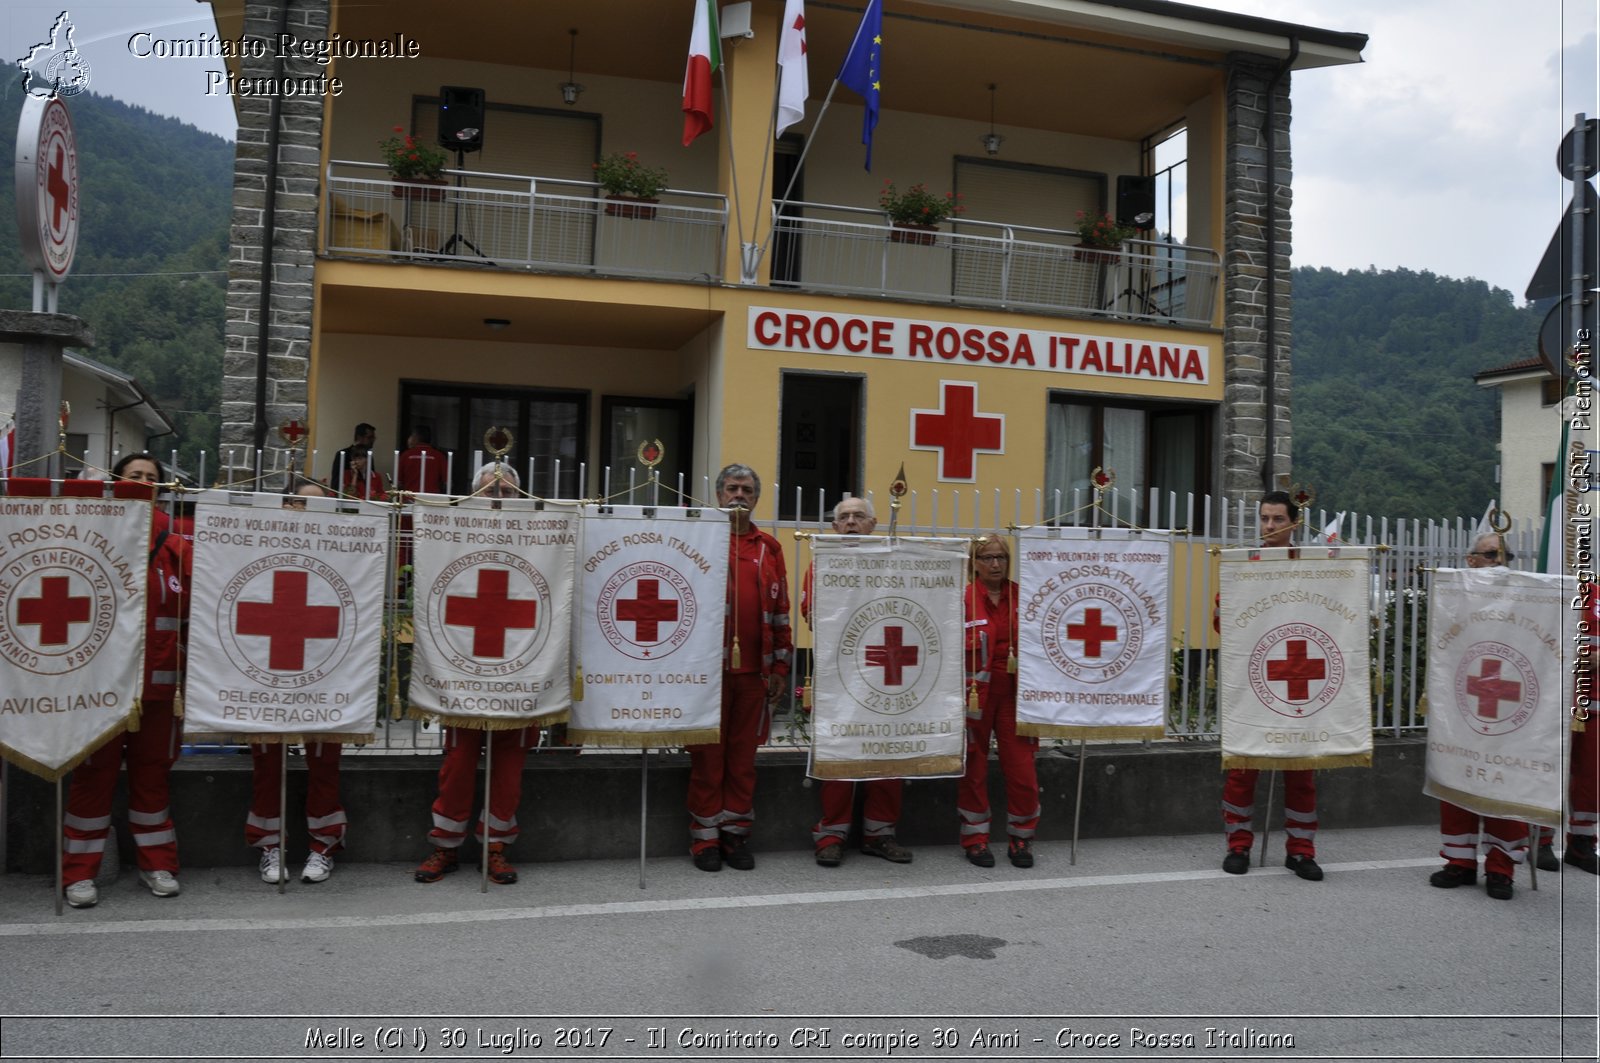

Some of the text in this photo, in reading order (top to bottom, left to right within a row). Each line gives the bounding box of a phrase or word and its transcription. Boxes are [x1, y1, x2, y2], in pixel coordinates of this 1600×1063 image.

[754, 311, 1205, 381] CROCE ROSSA ITALIANA
[50, 504, 70, 516] DEL
[75, 504, 126, 517] SOCCORSO
[207, 515, 377, 539] CORPO VOLONTARI DEL SOCCORSO
[422, 513, 569, 531] CORPO VOLONTARI DEL SOCCORSO
[197, 530, 385, 555] CROCE ROSSA ITALIANA
[415, 528, 576, 546] CROCE ROSSA ITALIANA
[8, 523, 140, 600] ROSSA ITALIANA
[584, 532, 712, 575] CROCE ROSSA ITALIANA
[1026, 551, 1053, 562] CORPO
[1056, 551, 1100, 563] VOLONTARI
[1104, 552, 1119, 563] DEL
[10, 561, 26, 577] DI
[31, 551, 95, 575] GINEVRA
[94, 575, 108, 592] 22
[223, 555, 353, 608] CONVENZIONE DI GINEVRA
[432, 552, 549, 600] CONVENZIONE DI GINEVRA
[822, 574, 956, 588] CROCE ROSSA ITALIANA
[1024, 564, 1162, 626] CROCE ROSSA ITALIANA
[600, 580, 622, 646] CONVENZIONE
[617, 571, 628, 582] DI
[628, 564, 671, 579] GINEVRA
[670, 574, 684, 588] 22
[679, 586, 695, 627] AGOSTO
[1060, 594, 1073, 606] DI
[1123, 606, 1137, 620] 22
[1234, 590, 1358, 629] CROCE ROSSA ITALIANA
[93, 595, 113, 642] AGOSTO
[1470, 609, 1516, 624] ROSSA
[841, 600, 939, 656] CONVENZIONE DI GINEVRA
[66, 643, 97, 667] 1864
[1251, 640, 1275, 705] CONVENZIONE
[1266, 633, 1278, 644] DI
[1278, 625, 1317, 639] GINEVRA
[1317, 634, 1330, 647] 22
[423, 674, 482, 692] COMITATO
[487, 681, 541, 693] LOCALE
[585, 673, 708, 685] COMITATO LOCALE
[218, 689, 351, 705] DELEGAZIONE DI
[439, 695, 539, 712] RACCONIGI
[641, 691, 653, 700] DI
[1022, 690, 1160, 706] GRUPPO DI PONTECHIANALE
[222, 705, 343, 723] PEVERAGNO
[611, 708, 682, 720] DRONERO
[830, 720, 952, 737] COMITATO LOCALE DI
[1264, 731, 1330, 744] CENTALLO
[861, 740, 927, 755] MONESIGLIO
[1430, 741, 1481, 762] COMITATO
[1485, 754, 1538, 772] LOCALE
